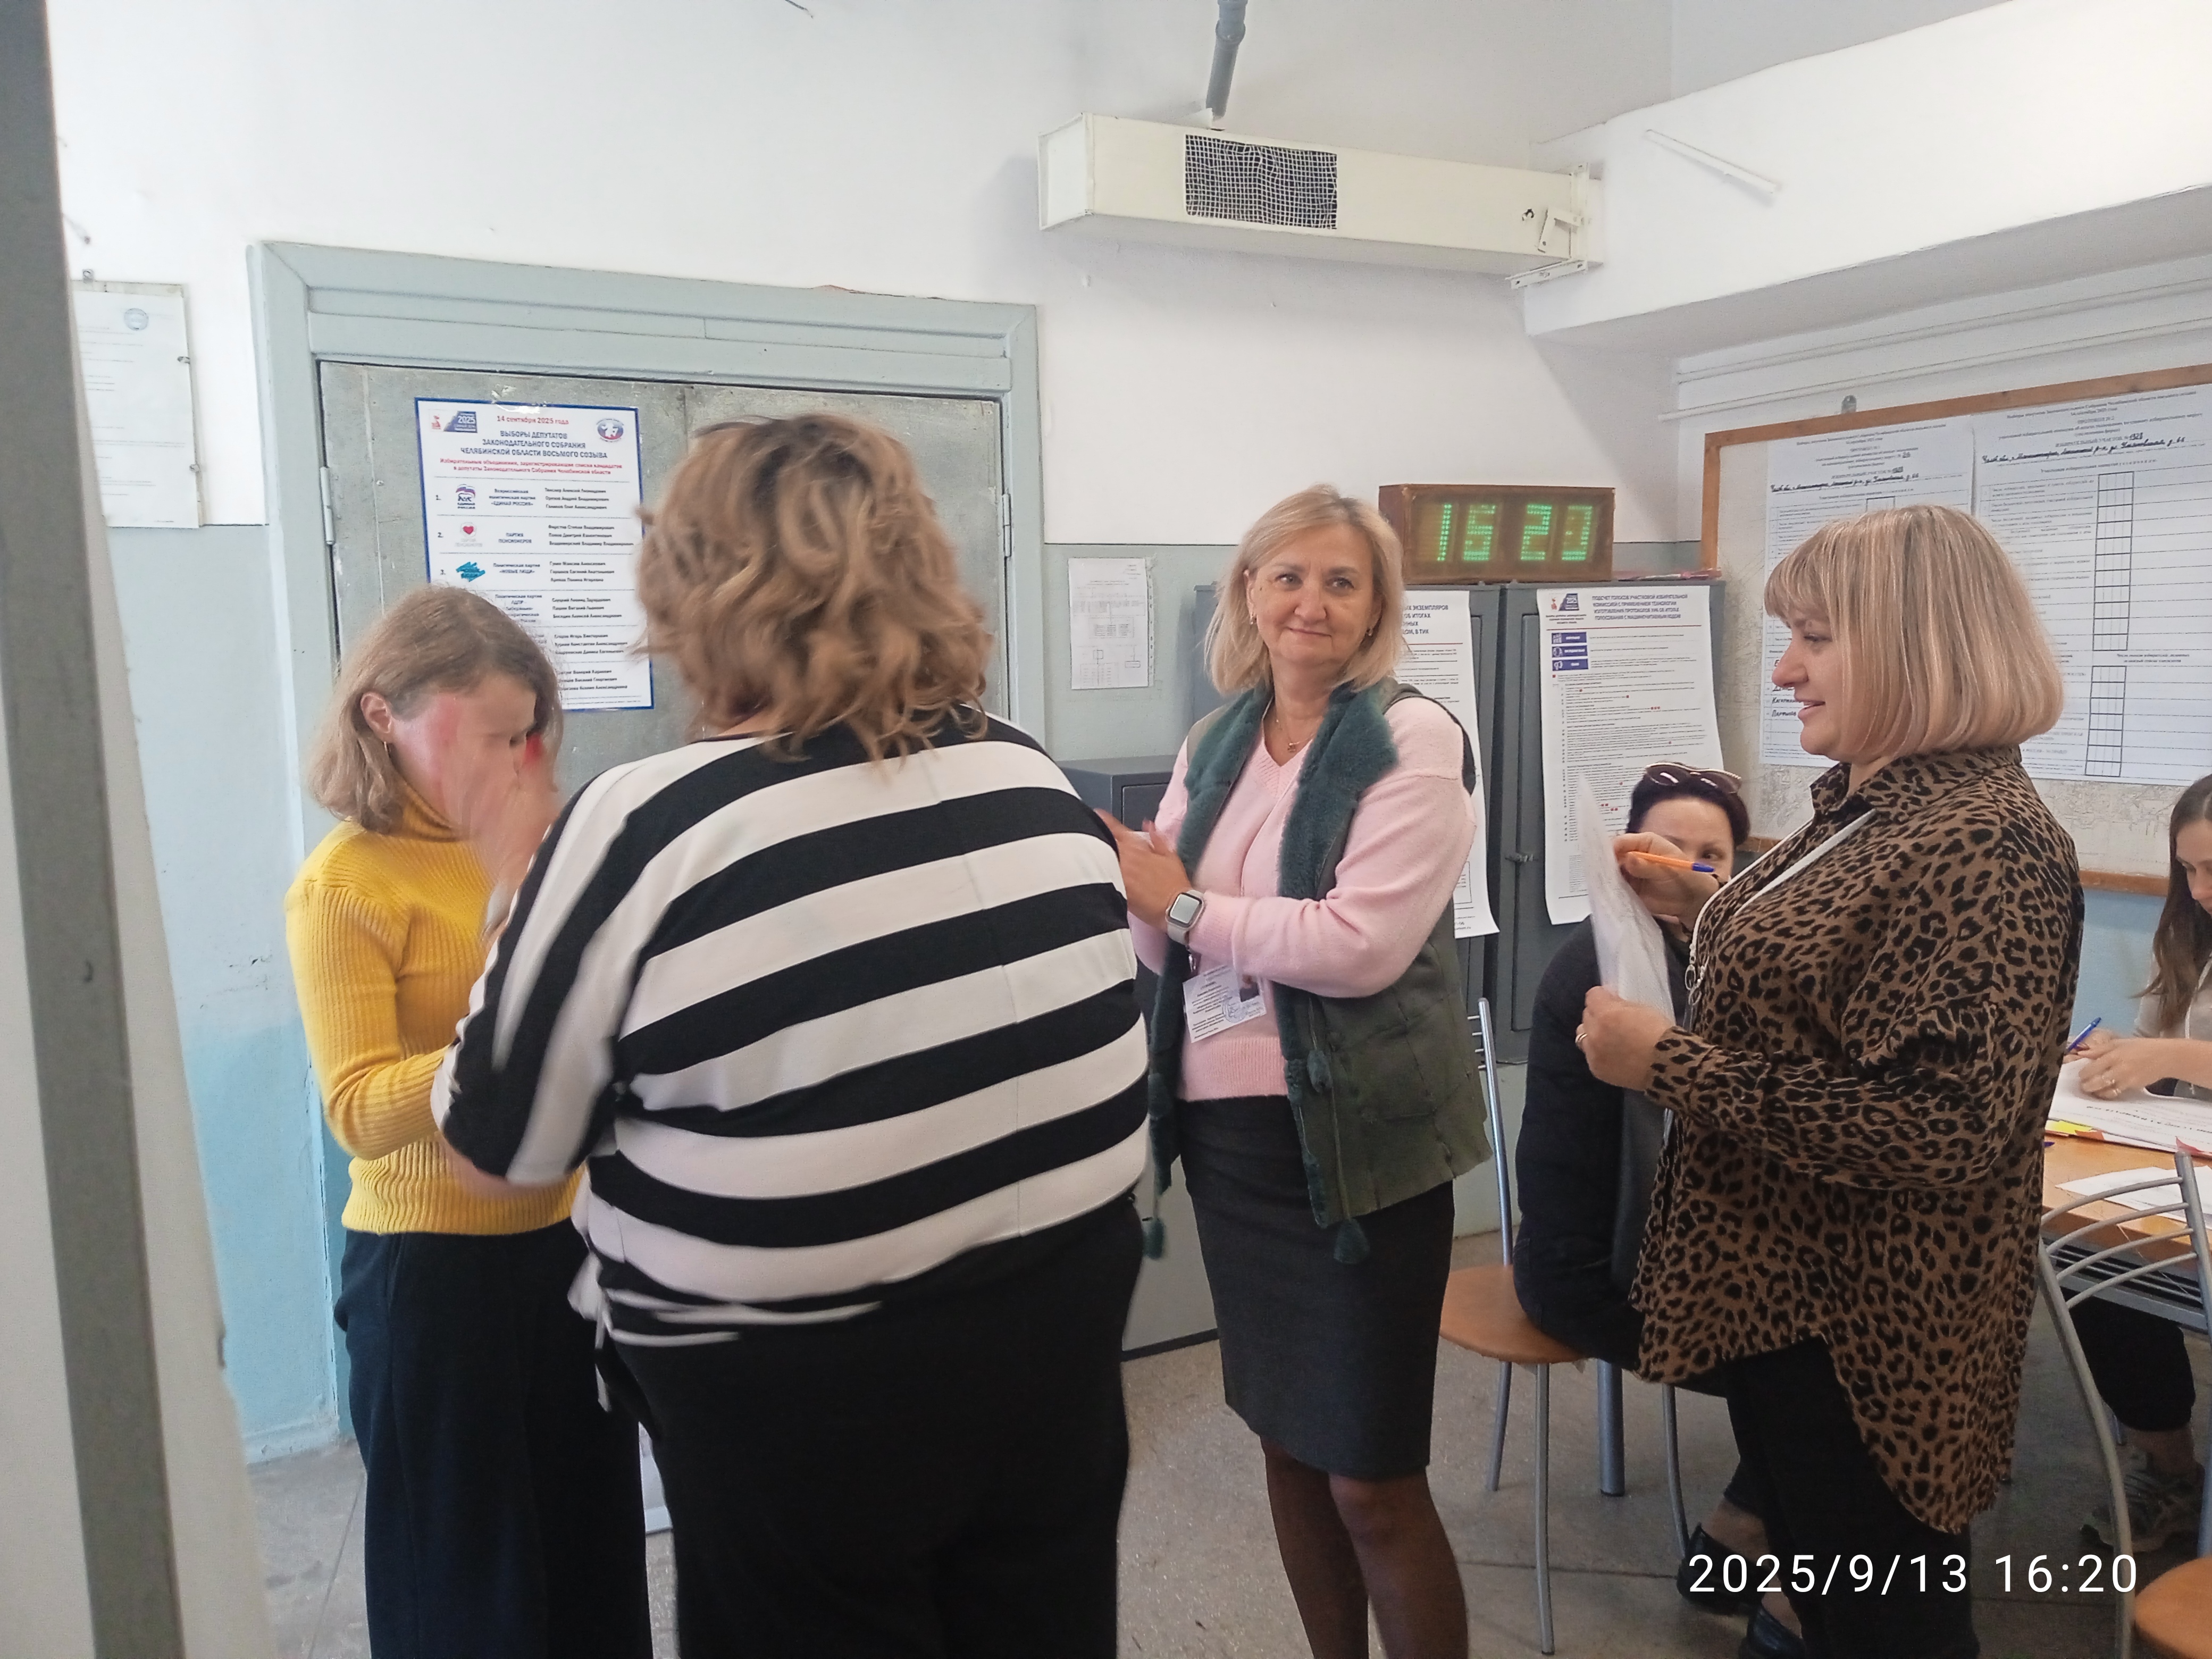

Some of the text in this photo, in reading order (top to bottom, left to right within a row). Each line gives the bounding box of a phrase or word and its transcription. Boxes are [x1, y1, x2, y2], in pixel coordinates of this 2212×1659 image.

[458, 415, 476, 424] 2025
[482, 439, 549, 447] ЗАКОНОДАТЕЛЬНОГО
[460, 447, 510, 456] ЧЕЛЯБИНСКОЙ
